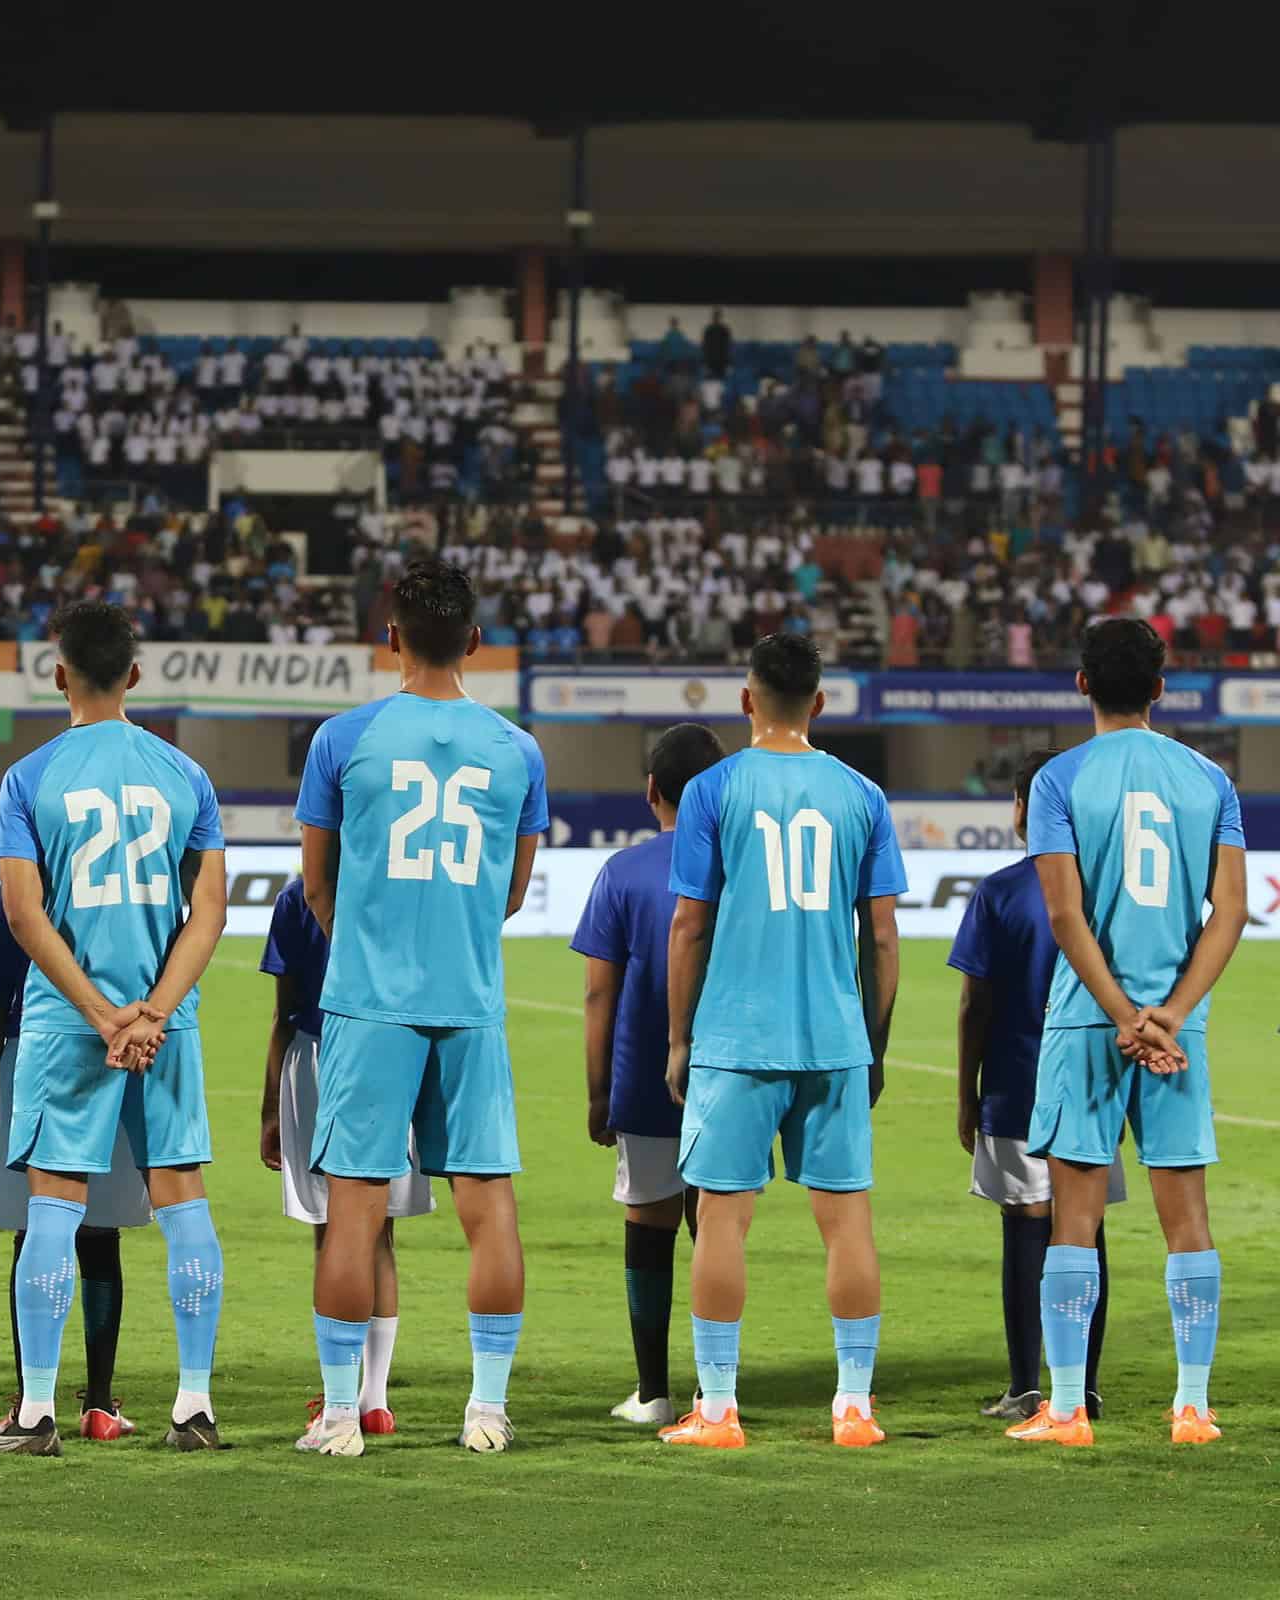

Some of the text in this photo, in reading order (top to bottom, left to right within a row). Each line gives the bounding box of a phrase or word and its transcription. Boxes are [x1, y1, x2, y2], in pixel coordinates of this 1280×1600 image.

[161, 650, 352, 690] ON INDIA
[63, 784, 171, 909] 22
[387, 759, 491, 886] 25
[754, 808, 832, 912] 10
[956, 826, 1015, 850] ODI
[1123, 791, 1172, 908] 6
